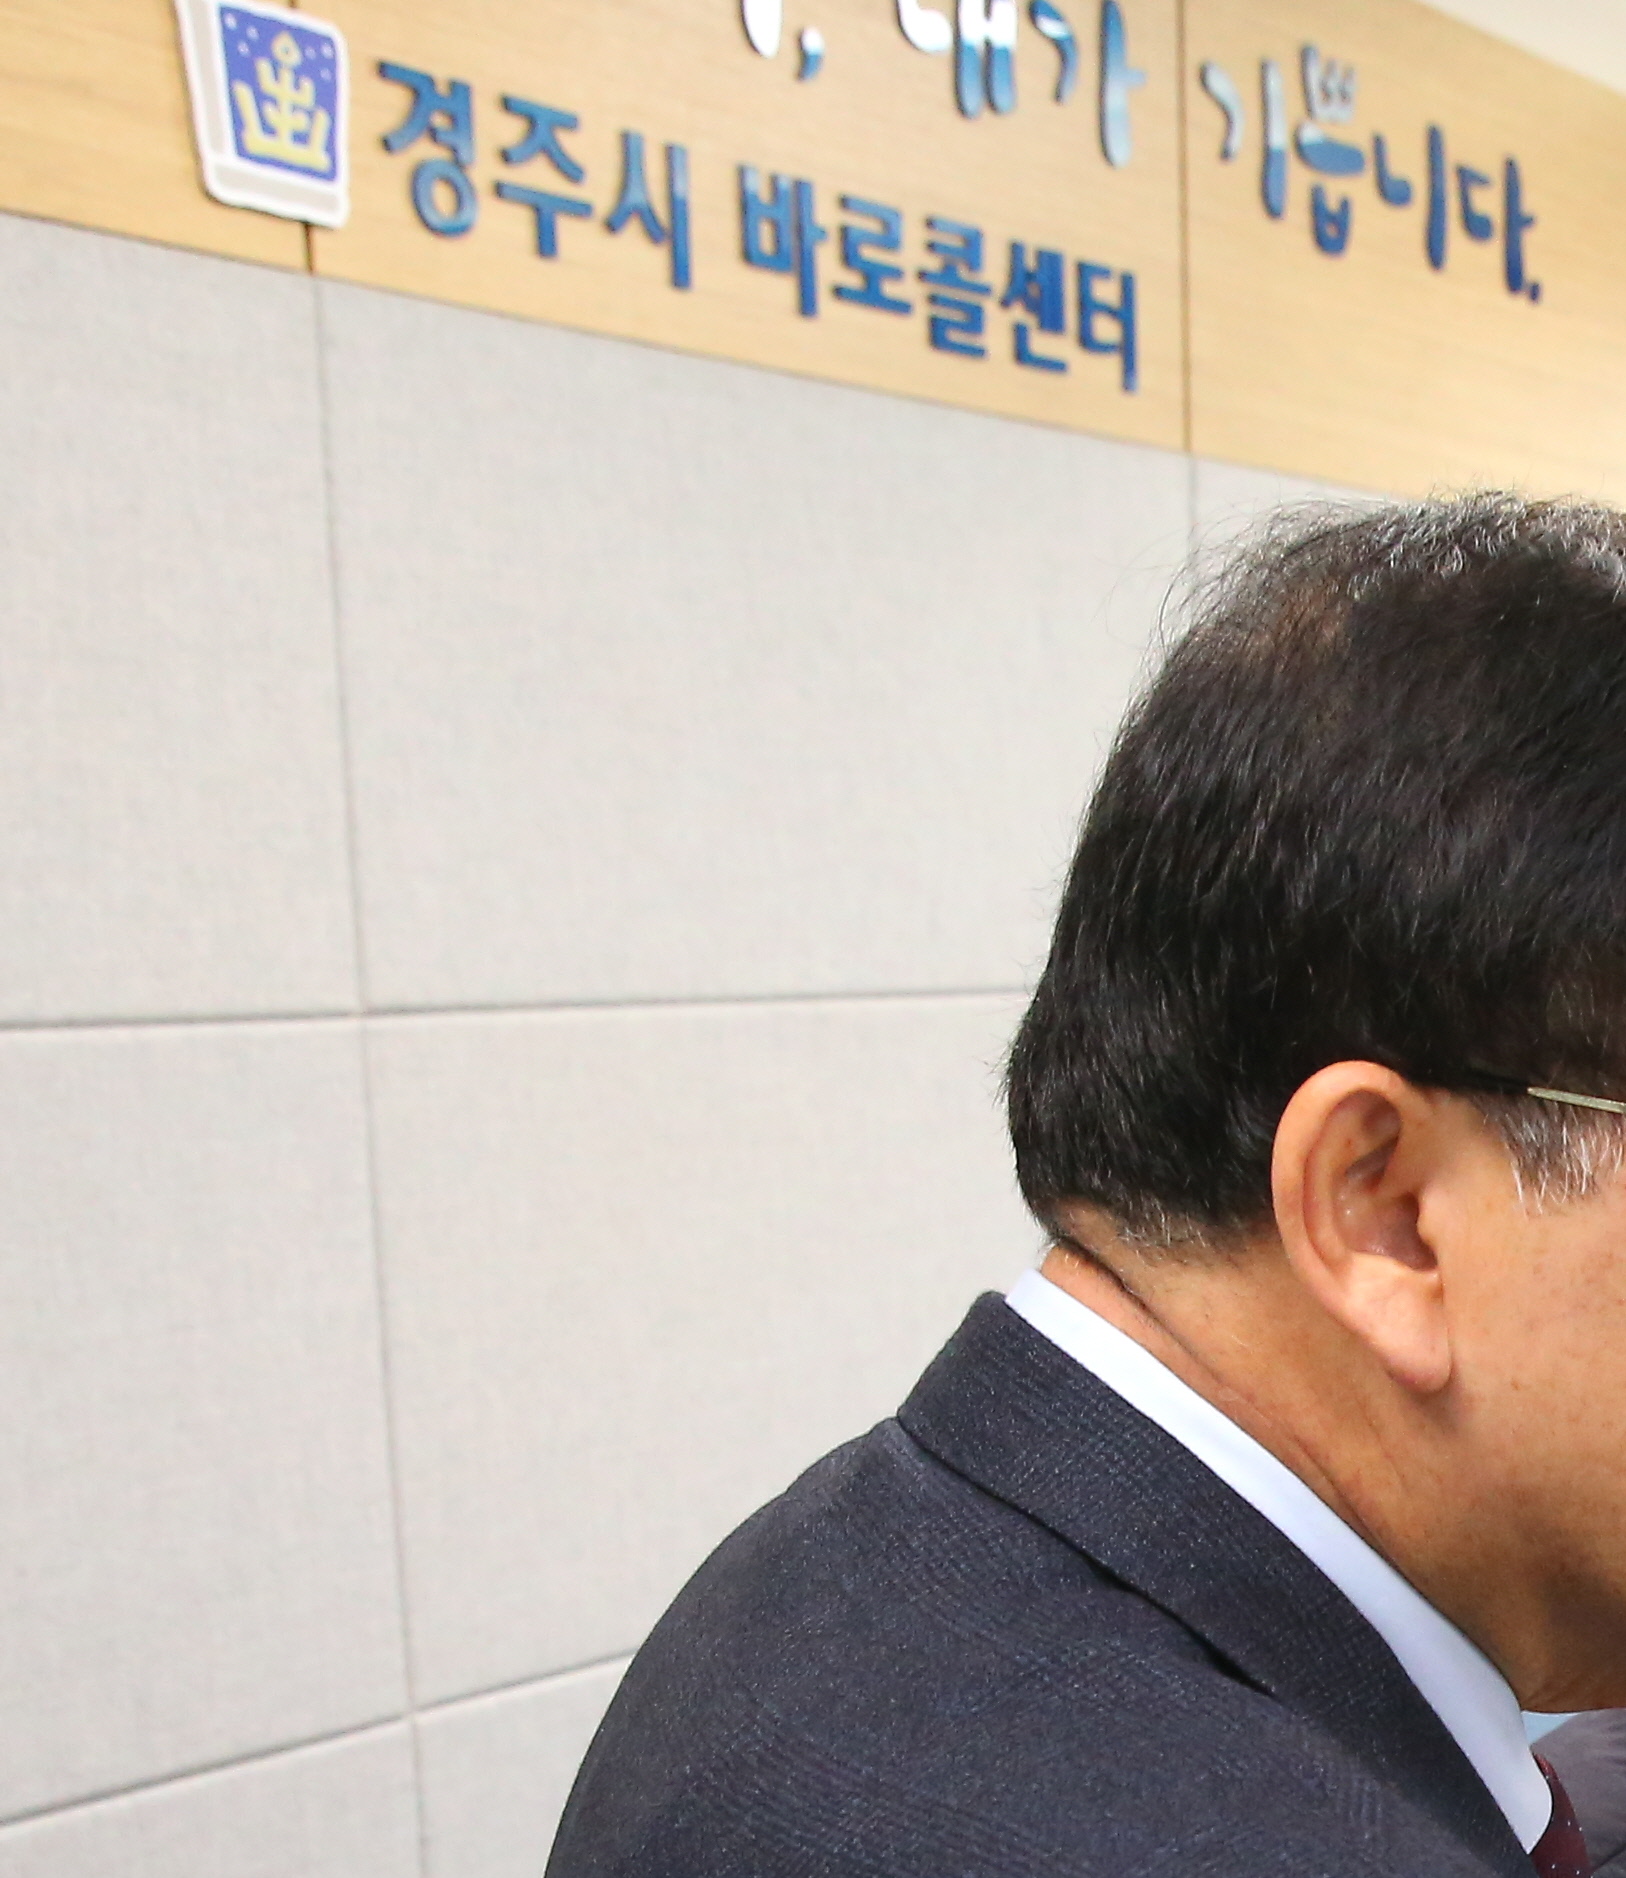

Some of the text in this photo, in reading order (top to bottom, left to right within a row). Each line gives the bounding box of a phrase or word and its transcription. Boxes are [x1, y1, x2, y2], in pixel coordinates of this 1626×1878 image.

[378, 60, 1138, 393] 경주시 바로콜센터
[1200, 42, 1541, 305] 기쁩니다.
